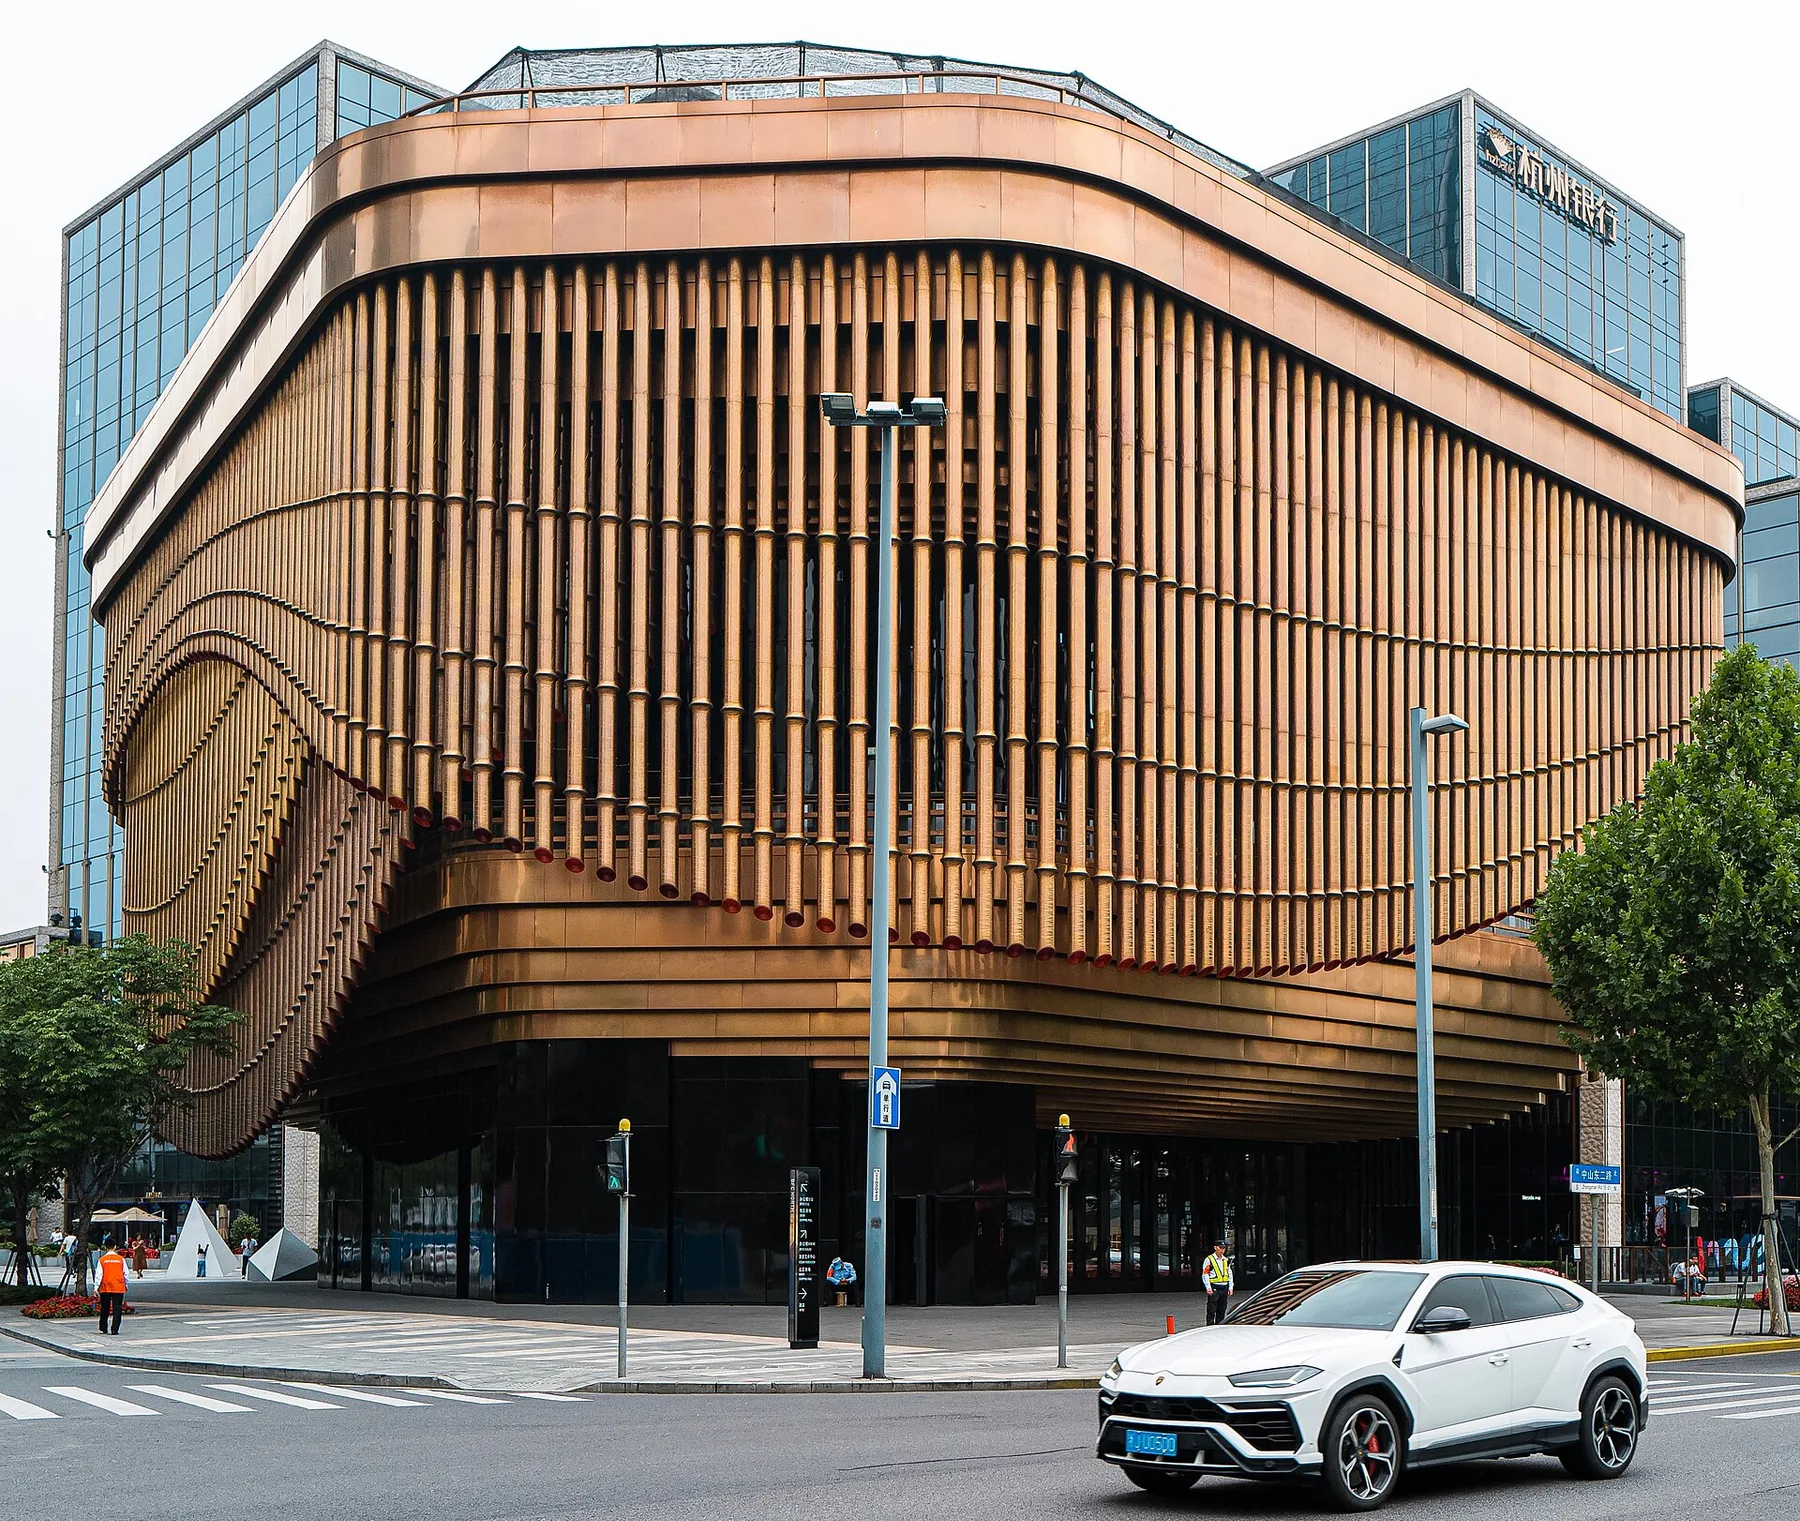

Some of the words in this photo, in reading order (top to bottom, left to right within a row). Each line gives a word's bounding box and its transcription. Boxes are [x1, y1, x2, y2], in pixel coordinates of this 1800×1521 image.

[1517, 144, 1619, 243] 杭州银行
[1581, 1169, 1612, 1181] 中山东二路
